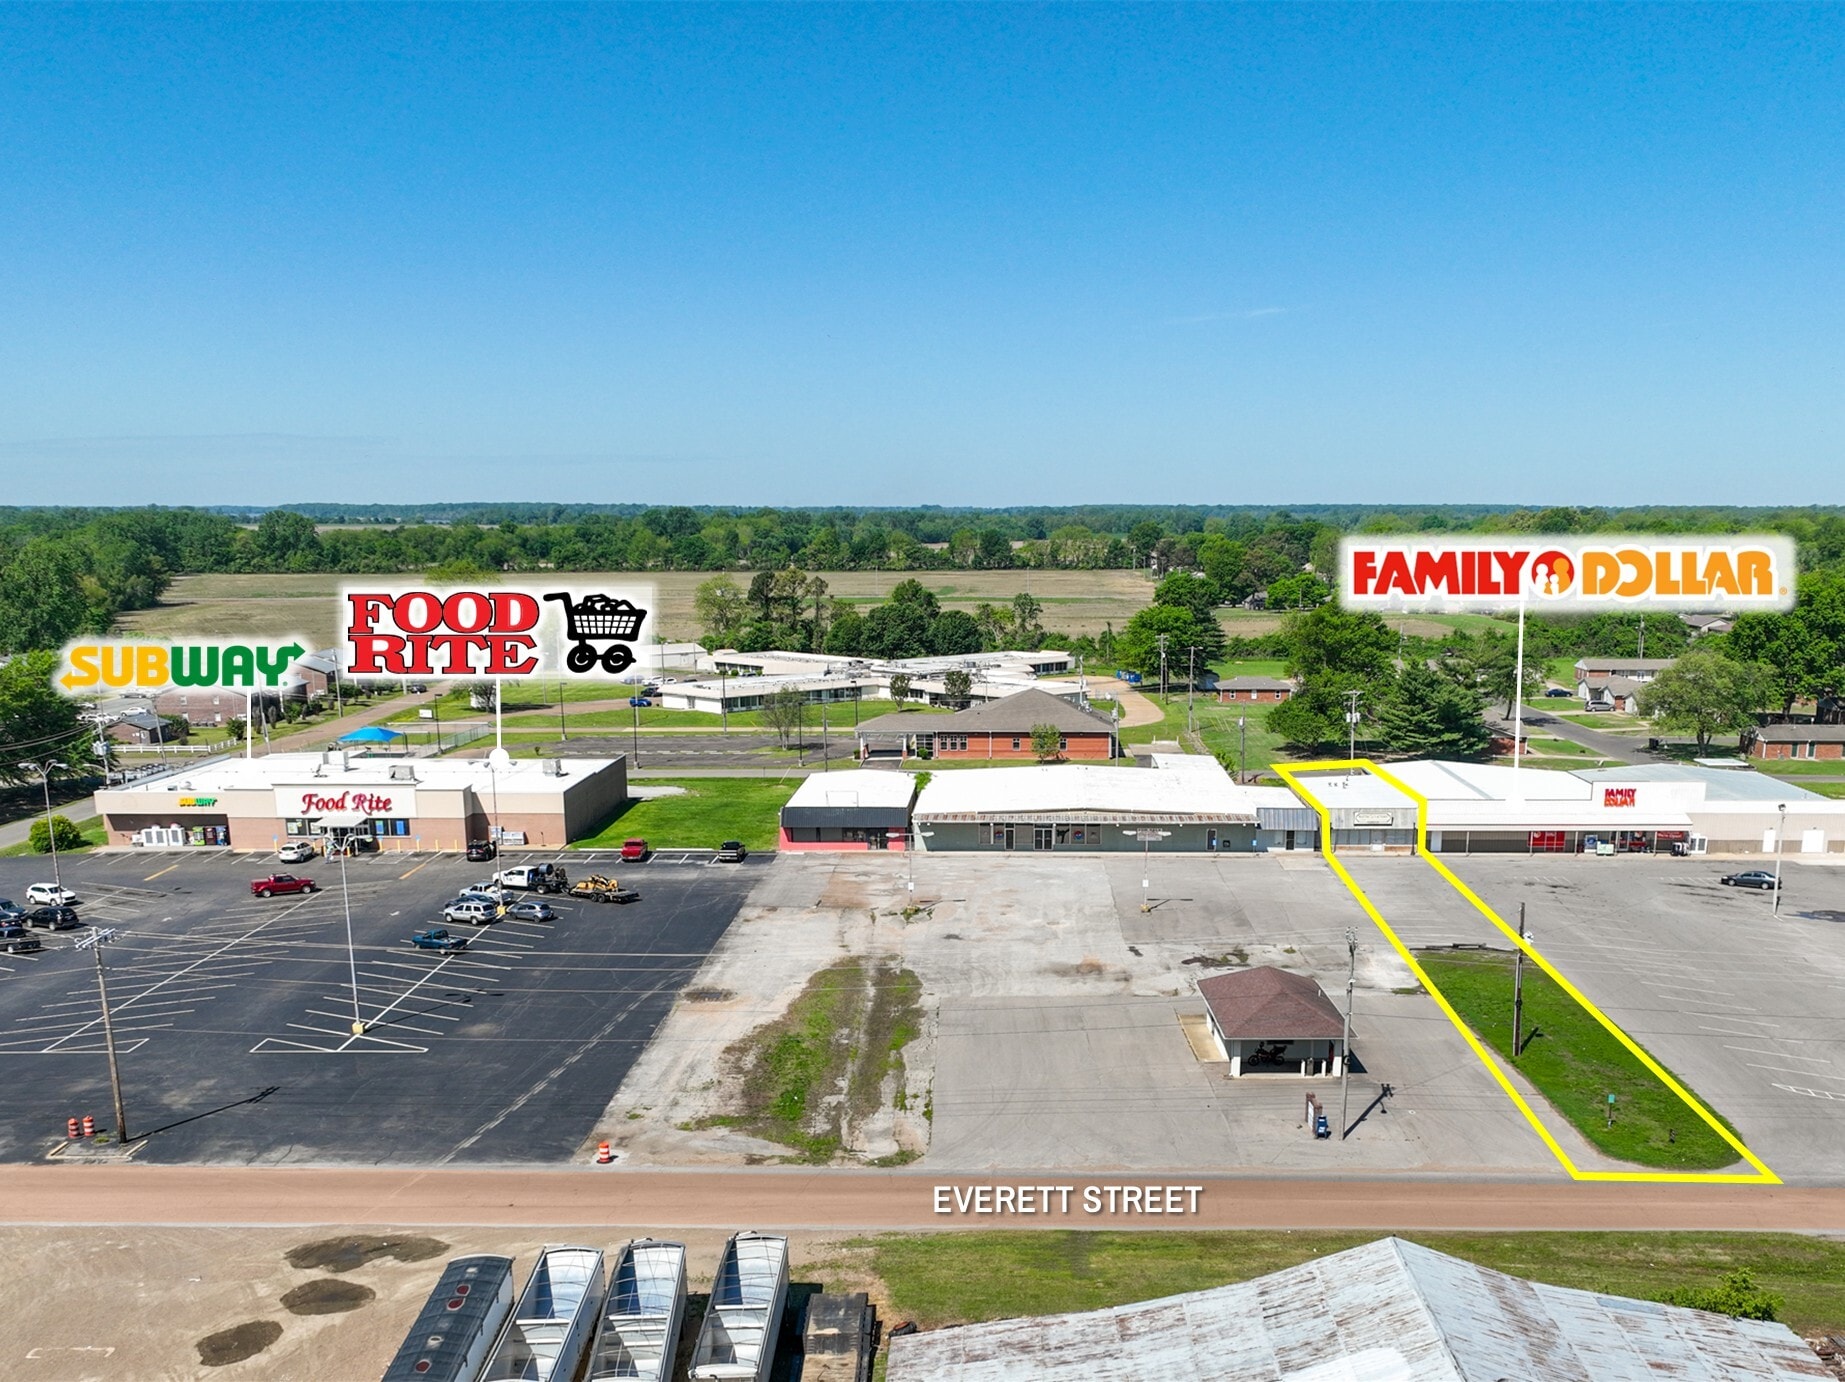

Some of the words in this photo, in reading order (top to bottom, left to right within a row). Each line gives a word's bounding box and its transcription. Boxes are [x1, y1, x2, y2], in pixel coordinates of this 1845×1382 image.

[179, 797, 218, 807] SUBWAY
[301, 791, 350, 815] Food
[352, 793, 392, 816] Rite
